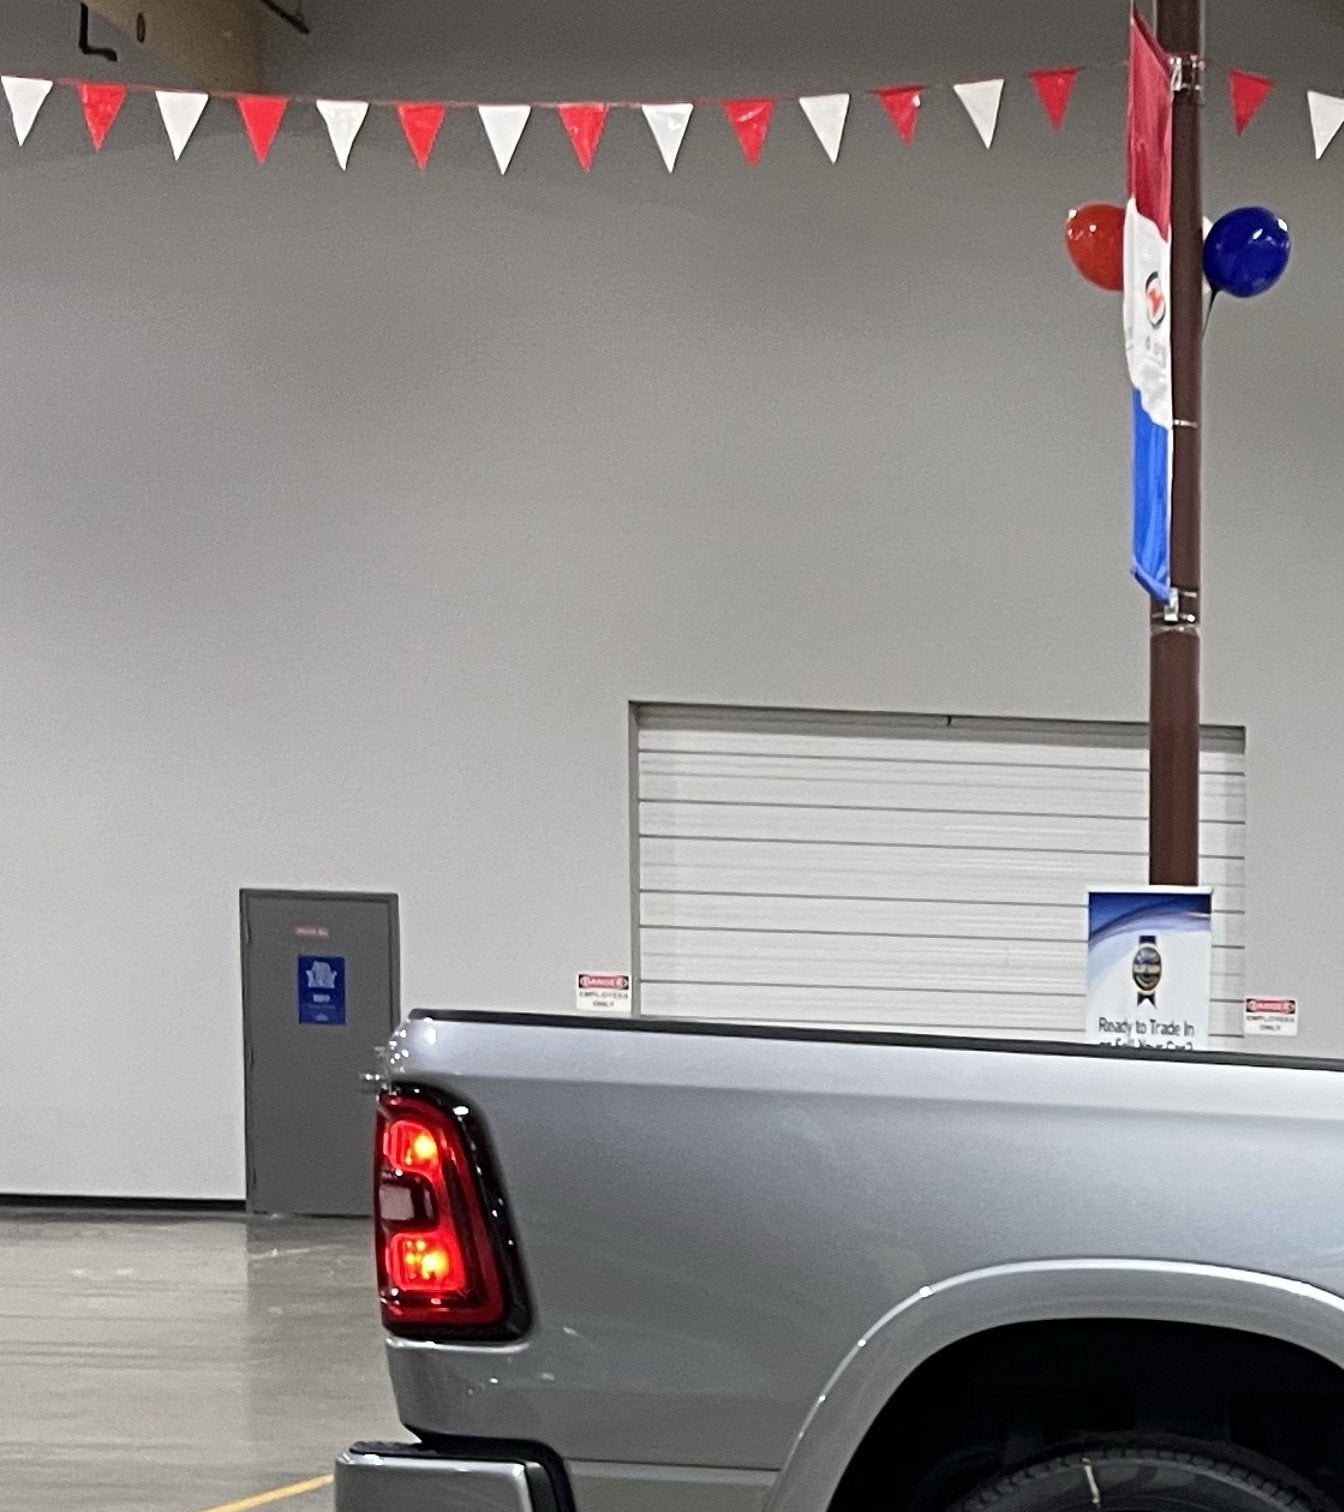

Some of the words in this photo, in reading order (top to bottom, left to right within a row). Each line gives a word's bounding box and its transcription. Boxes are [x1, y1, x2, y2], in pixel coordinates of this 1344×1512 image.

[1099, 1016, 1132, 1037] Ready
[1135, 1019, 1148, 1034] to
[1150, 1018, 1181, 1036] Trade
